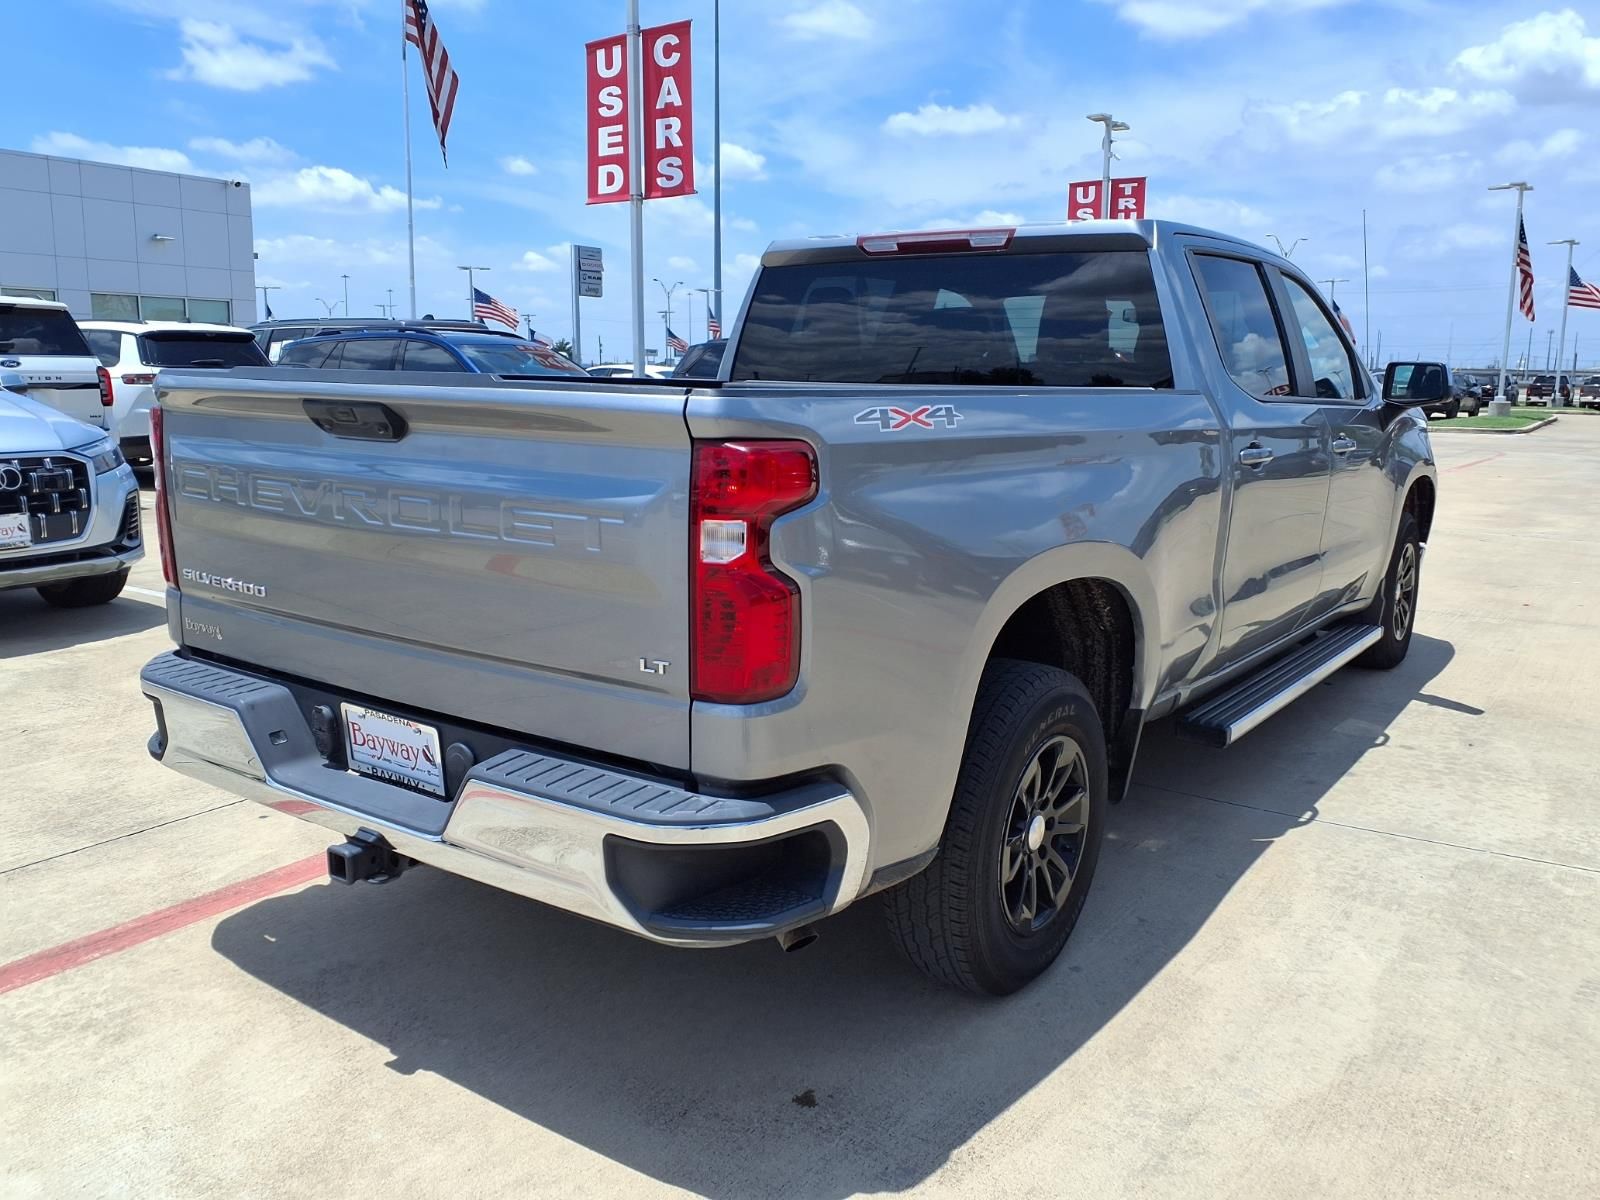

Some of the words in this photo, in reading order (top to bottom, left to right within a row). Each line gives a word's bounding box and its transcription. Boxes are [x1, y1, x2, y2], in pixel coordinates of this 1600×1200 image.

[596, 44, 624, 195] USED
[653, 33, 684, 189] CARS
[176, 463, 625, 552] CHEVROLET
[183, 568, 266, 598] SILVERADO
[185, 617, 218, 637] Bayway
[639, 657, 671, 675] LT
[364, 709, 413, 728] PASADENA
[1024, 703, 1076, 755] GENERAL
[349, 721, 420, 771] Bayway
[371, 766, 420, 788] BAYWAY
